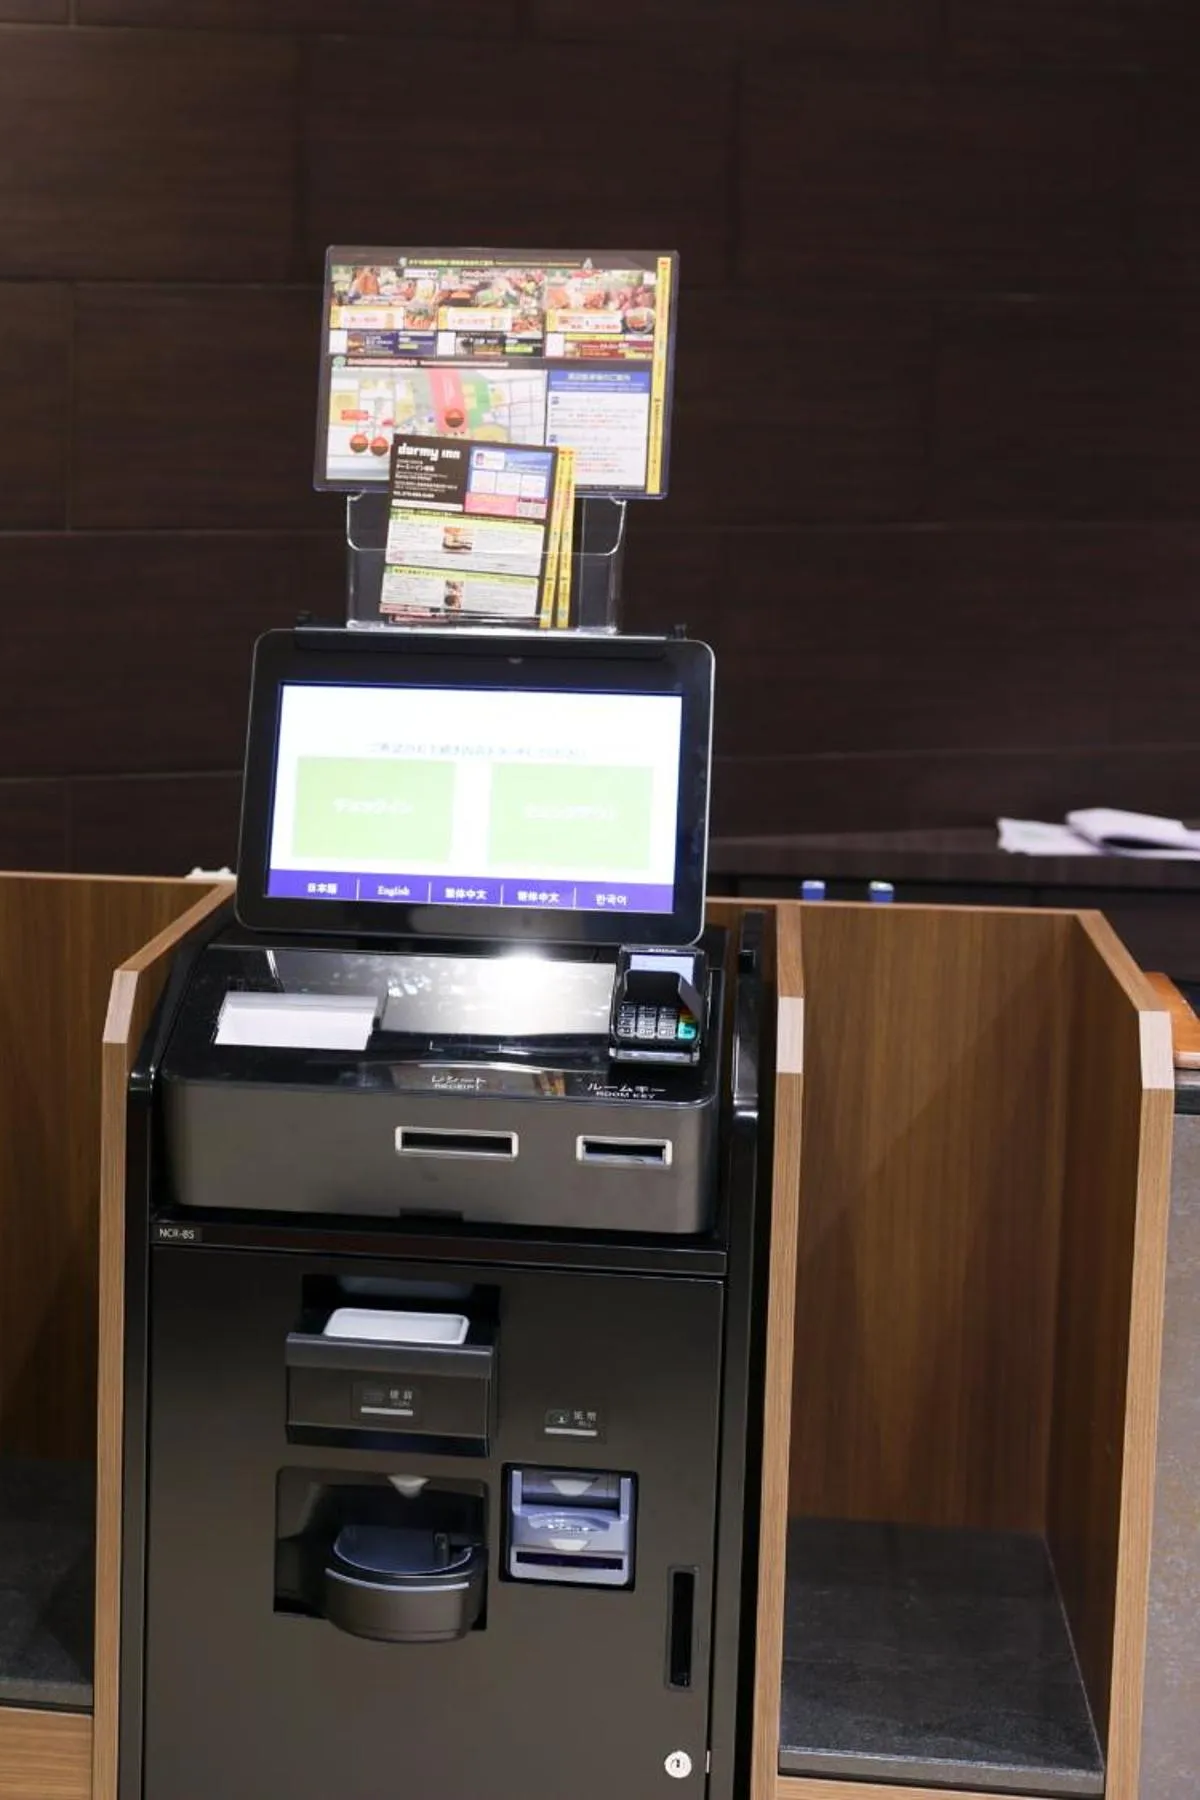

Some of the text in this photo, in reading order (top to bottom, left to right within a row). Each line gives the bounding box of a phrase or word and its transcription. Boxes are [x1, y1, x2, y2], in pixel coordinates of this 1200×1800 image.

[398, 443, 439, 461] dormy
[307, 882, 338, 895] 日本語
[377, 884, 411, 898] English
[596, 893, 627, 906] 한국어
[587, 1082, 667, 1093] ルームキー
